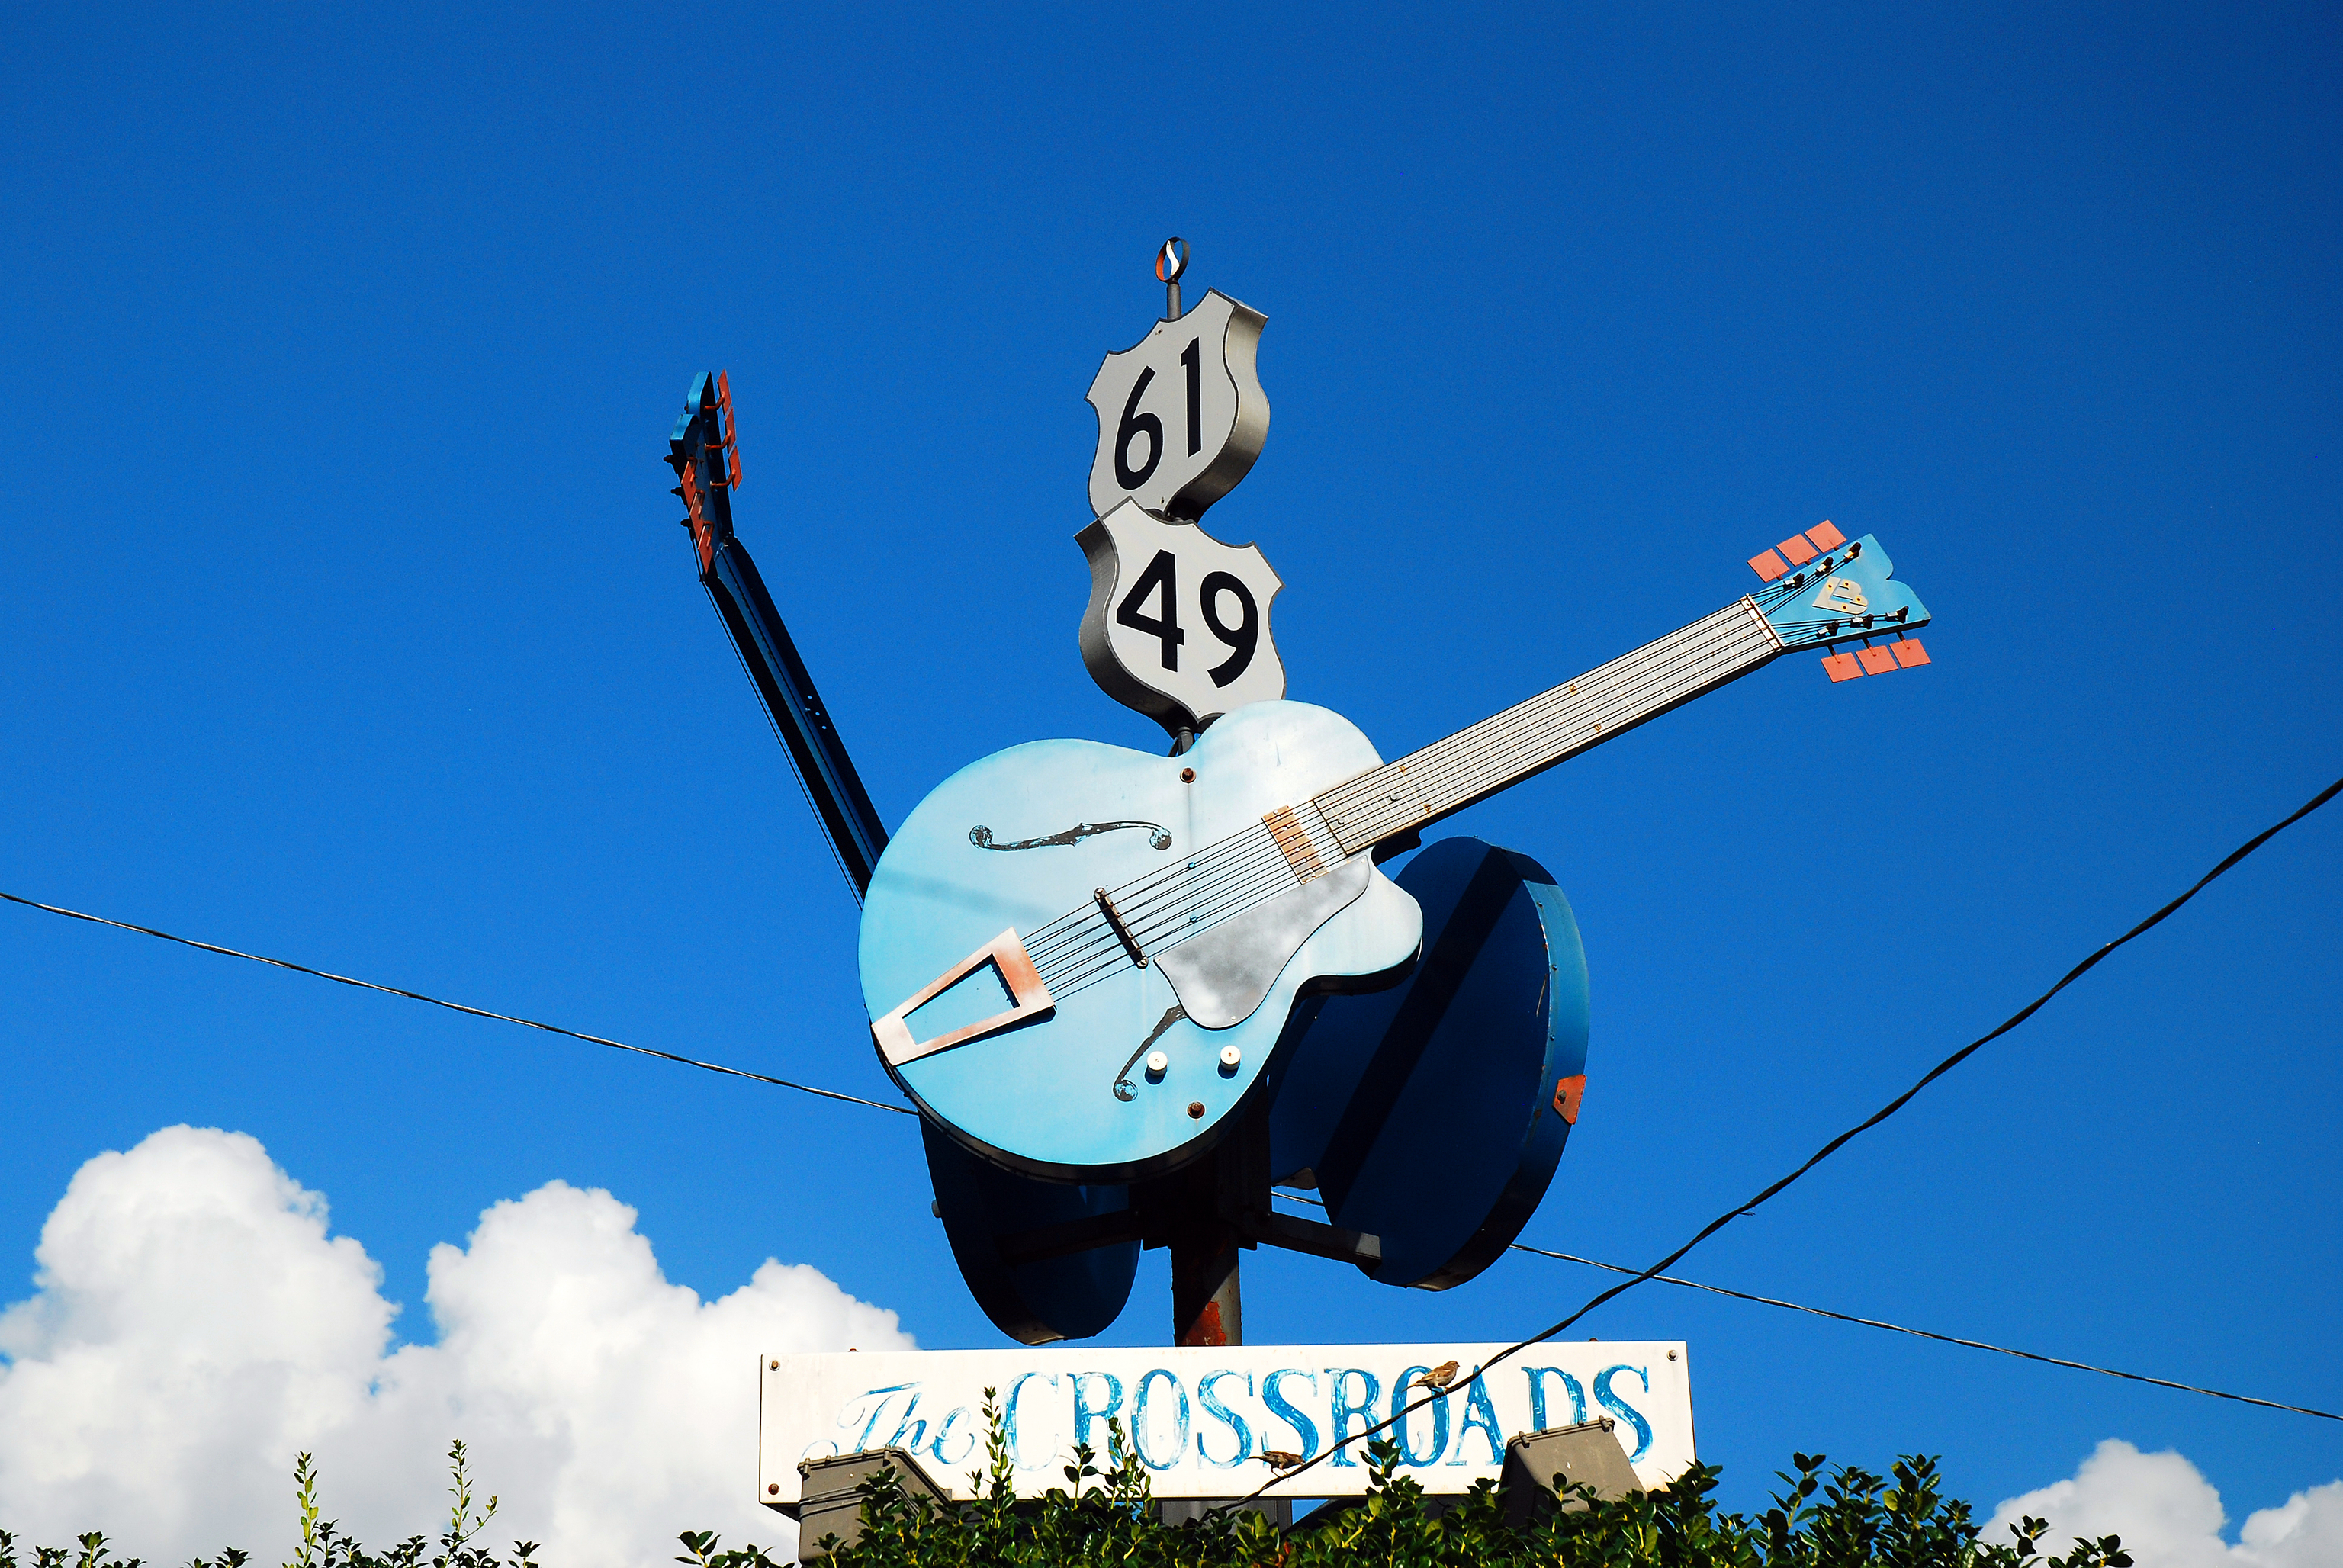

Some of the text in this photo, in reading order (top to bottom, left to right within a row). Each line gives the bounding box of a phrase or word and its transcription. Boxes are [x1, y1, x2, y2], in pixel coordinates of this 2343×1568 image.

[1114, 336, 1202, 490] 61
[1115, 549, 1259, 689] 49
[800, 1364, 1654, 1472] The CROSSROADS
